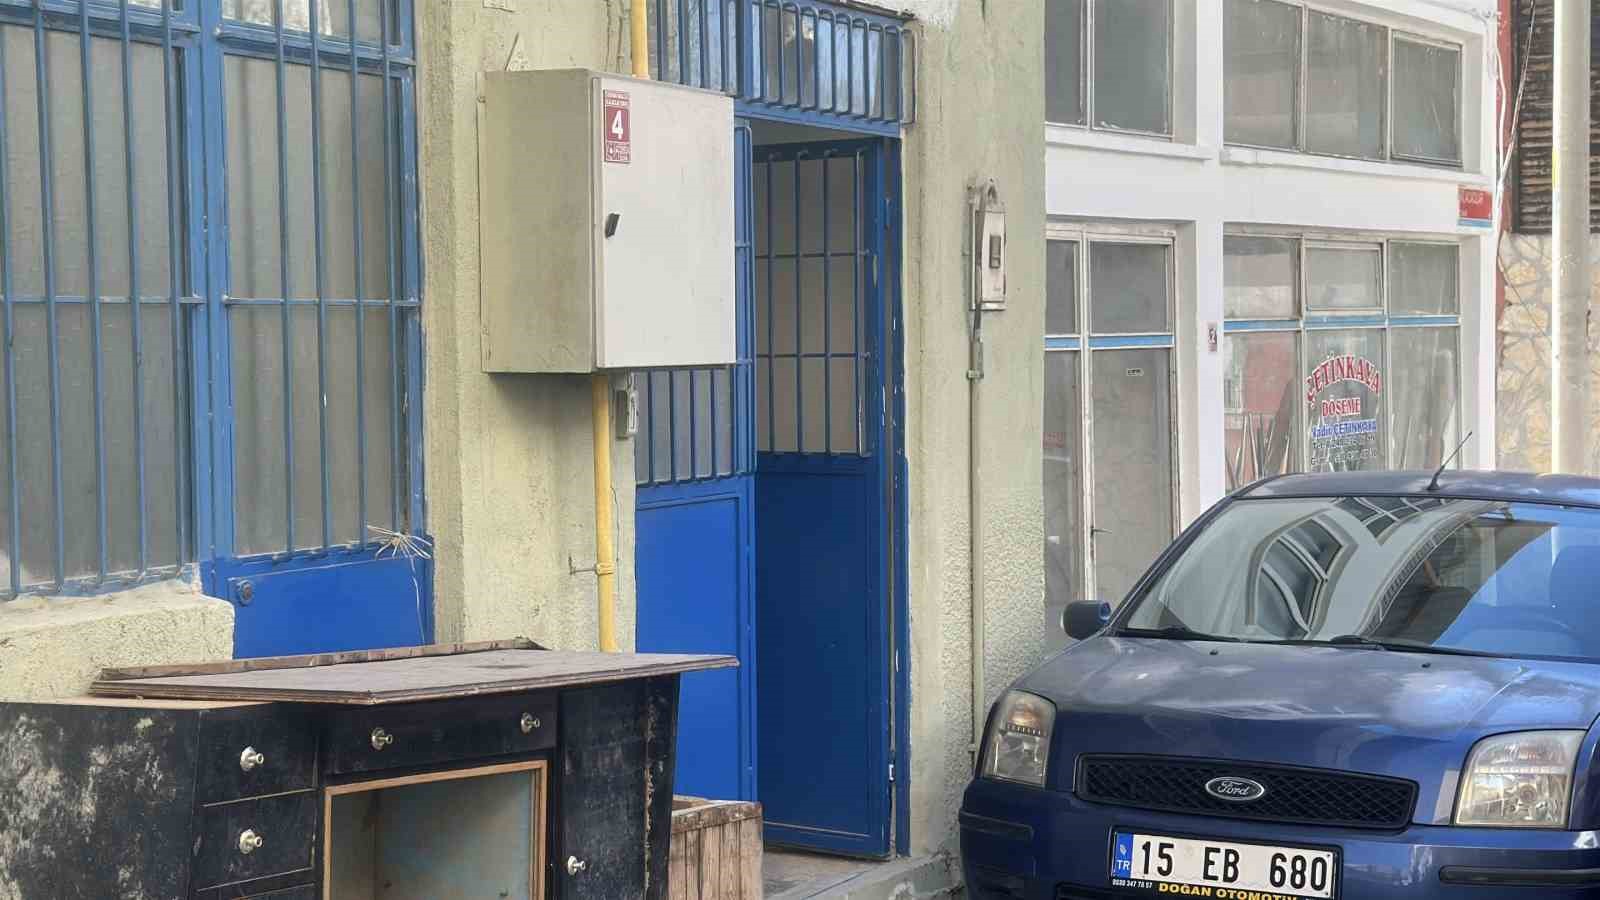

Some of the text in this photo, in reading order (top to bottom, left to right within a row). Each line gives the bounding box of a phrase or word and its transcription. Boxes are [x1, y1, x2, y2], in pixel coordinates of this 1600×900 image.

[611, 110, 623, 140] 4
[1217, 781, 1250, 796] Ford
[1116, 840, 1328, 891] TR 15 EB 680
[1158, 883, 1212, 896] DOĞAN
